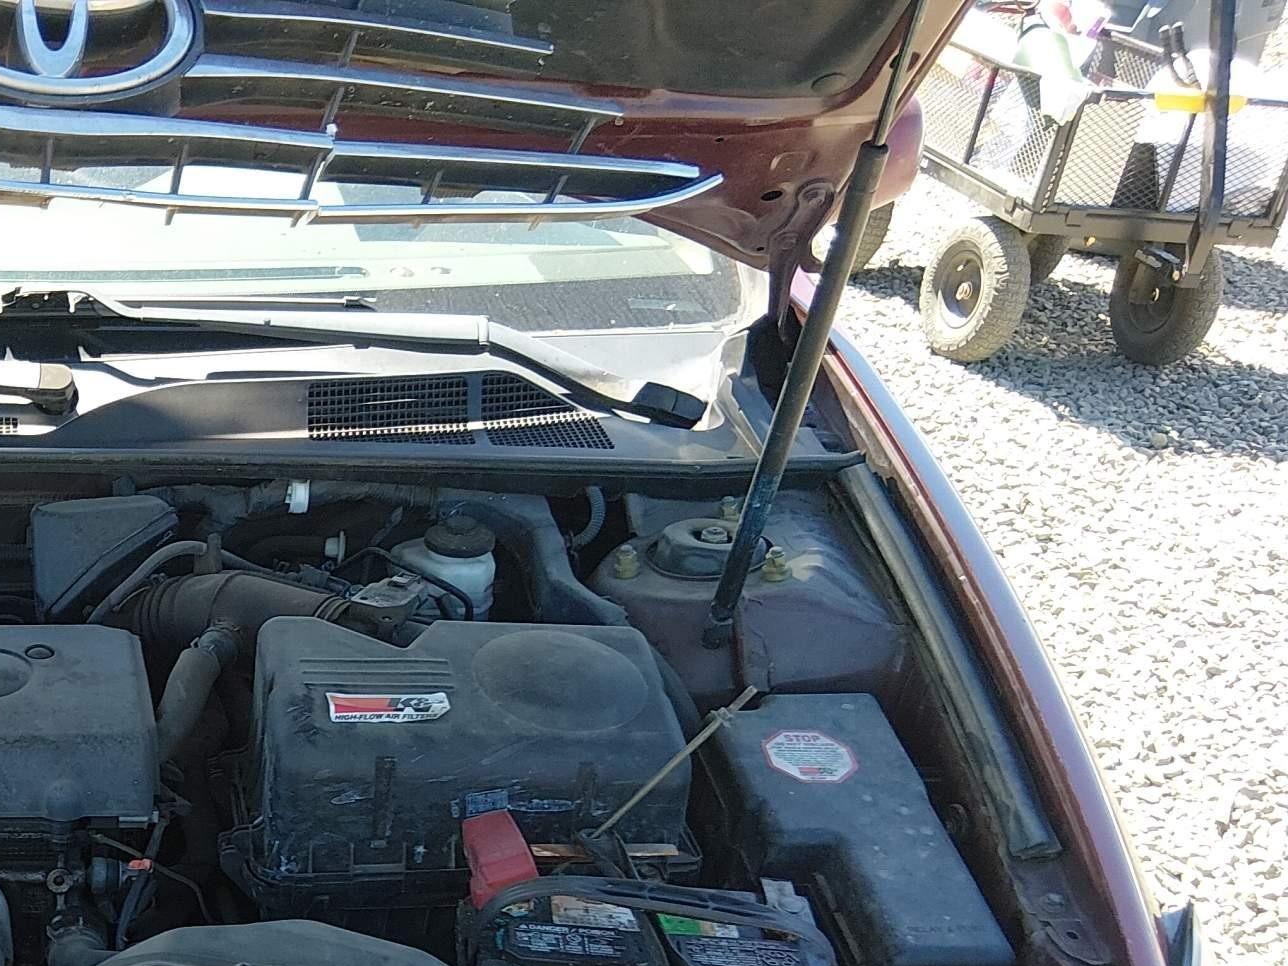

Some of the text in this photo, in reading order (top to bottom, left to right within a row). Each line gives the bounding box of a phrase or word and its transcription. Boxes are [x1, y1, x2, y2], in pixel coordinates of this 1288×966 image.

[334, 713, 383, 721] HIGH-FLOW
[783, 734, 821, 743] STOP
[528, 924, 569, 934] DANGER
